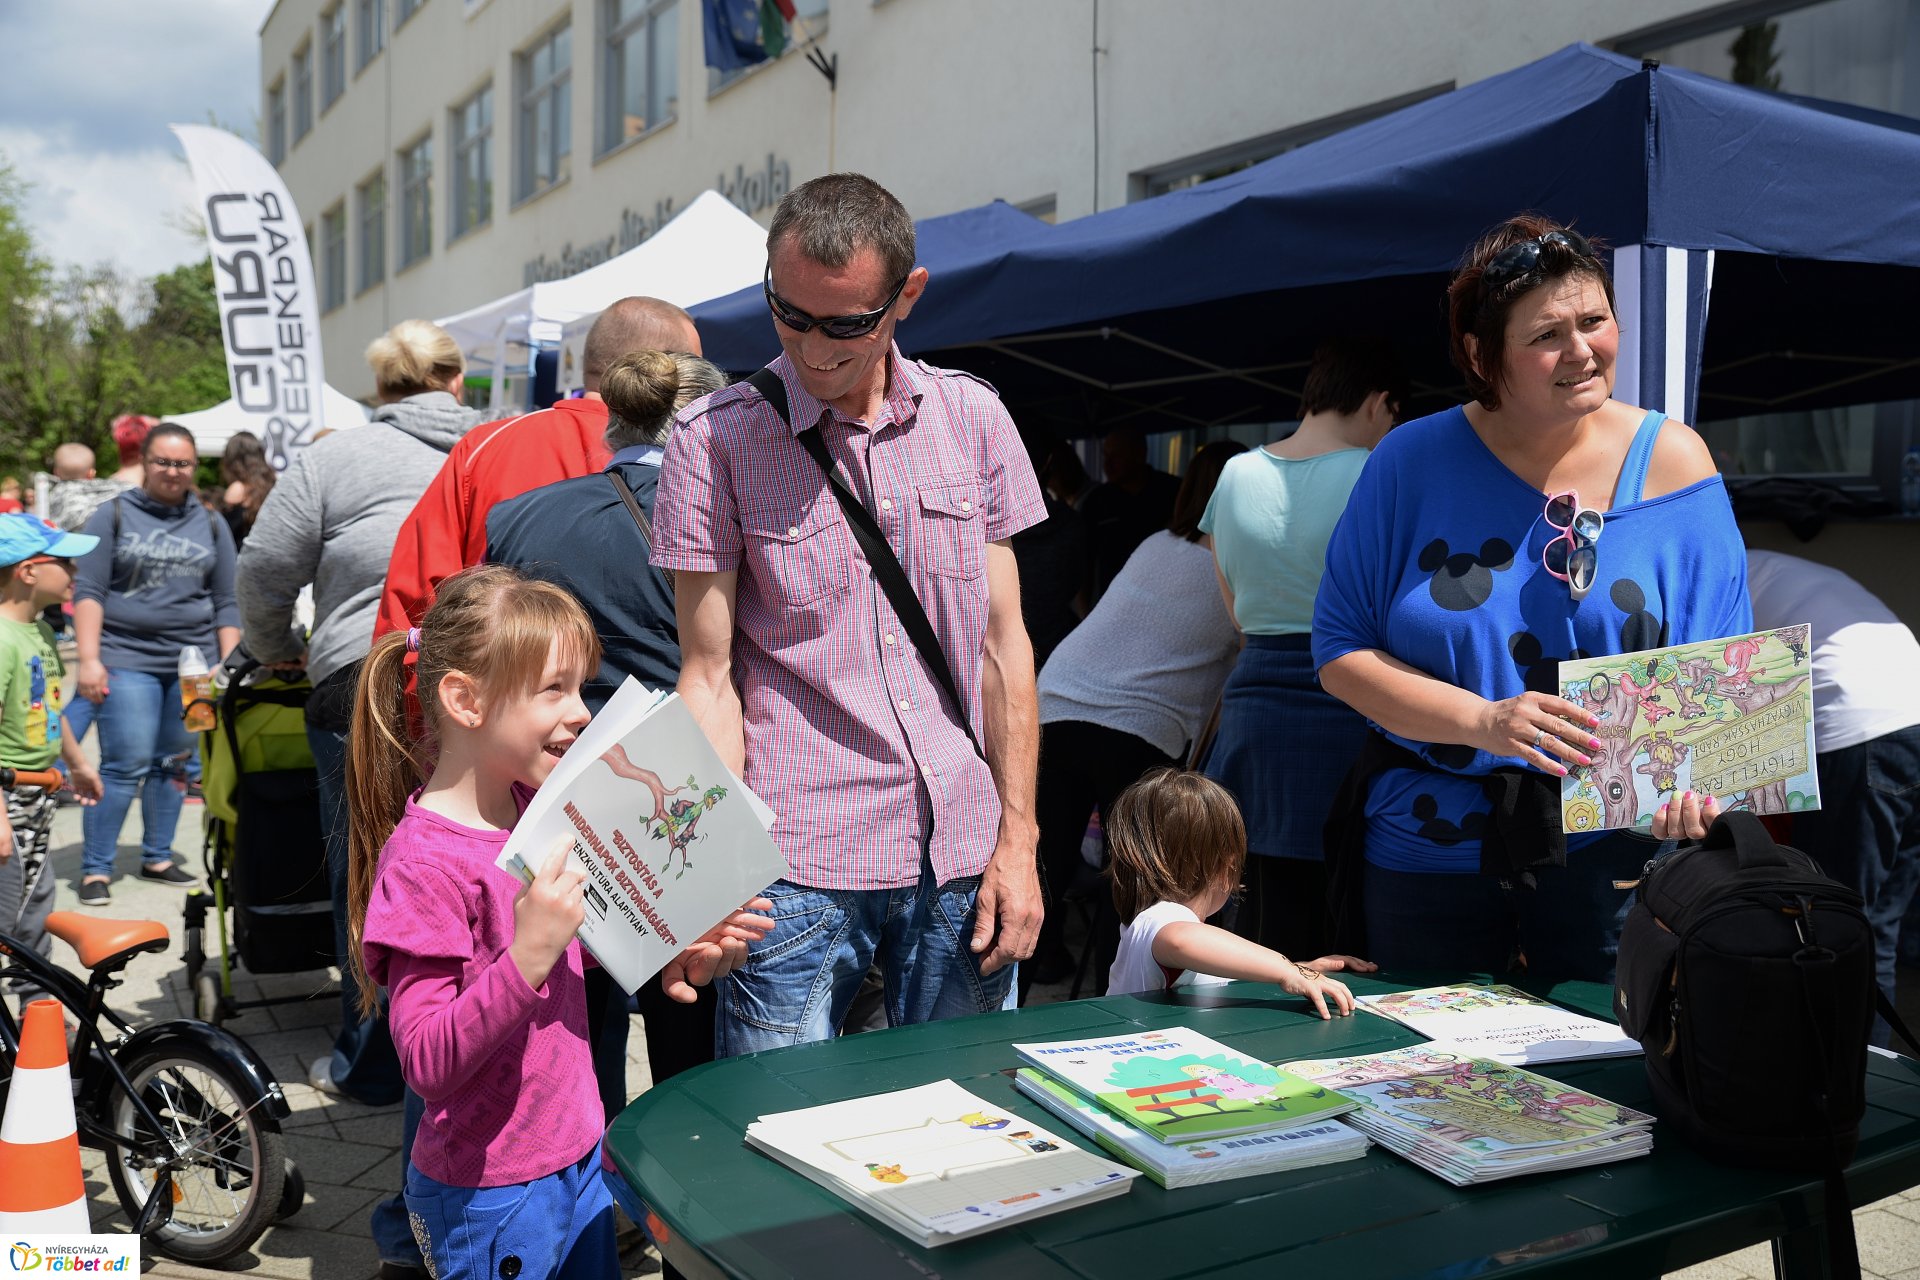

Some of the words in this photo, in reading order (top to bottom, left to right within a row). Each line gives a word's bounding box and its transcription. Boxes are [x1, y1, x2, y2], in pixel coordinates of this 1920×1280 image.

[1715, 737, 1762, 766] HOGY
[1730, 749, 1797, 785] FIGYELJ
[563, 801, 621, 875] MINDENNAPOK
[652, 886, 665, 900] A
[610, 891, 650, 938] ALAPÍTVÁNY
